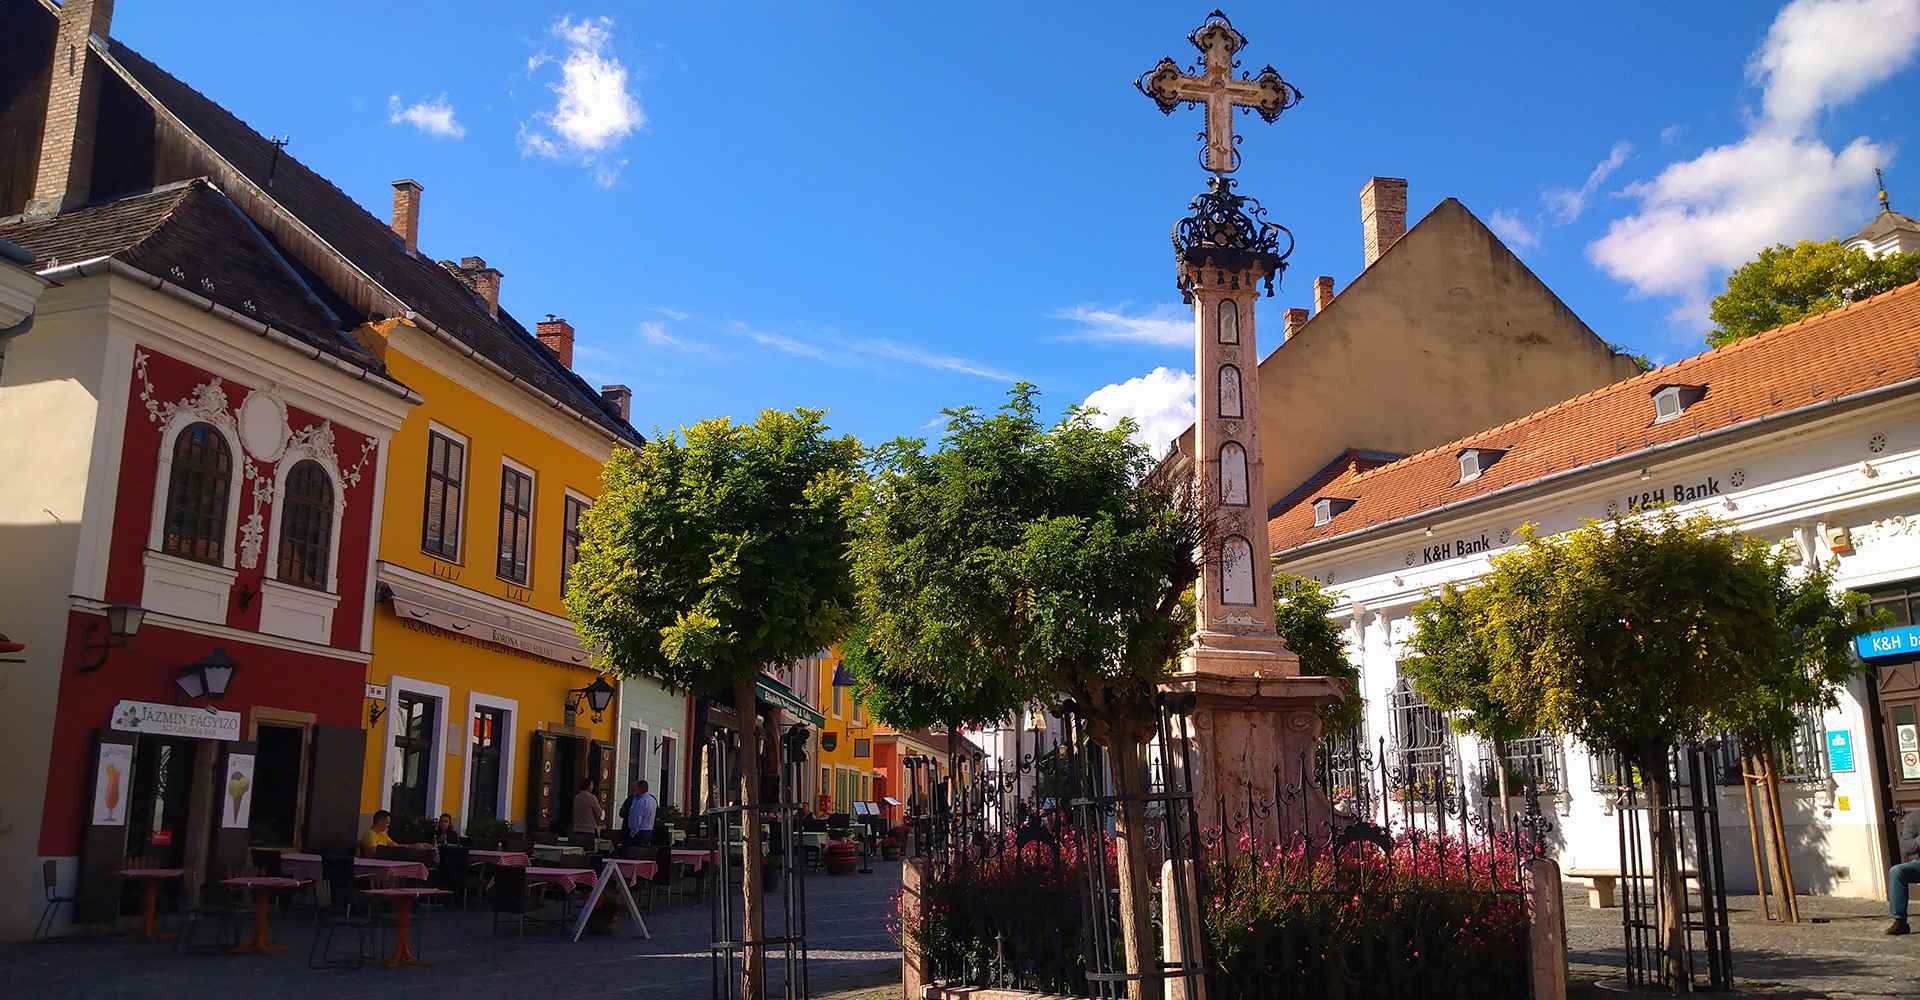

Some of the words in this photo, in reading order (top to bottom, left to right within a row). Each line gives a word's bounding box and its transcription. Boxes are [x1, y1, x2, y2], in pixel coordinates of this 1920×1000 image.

[1627, 488, 1665, 511] K&H
[1673, 477, 1720, 502] Bank
[1423, 542, 1450, 564] K&H
[1456, 534, 1491, 556] Bank
[1872, 634, 1902, 652] K&H
